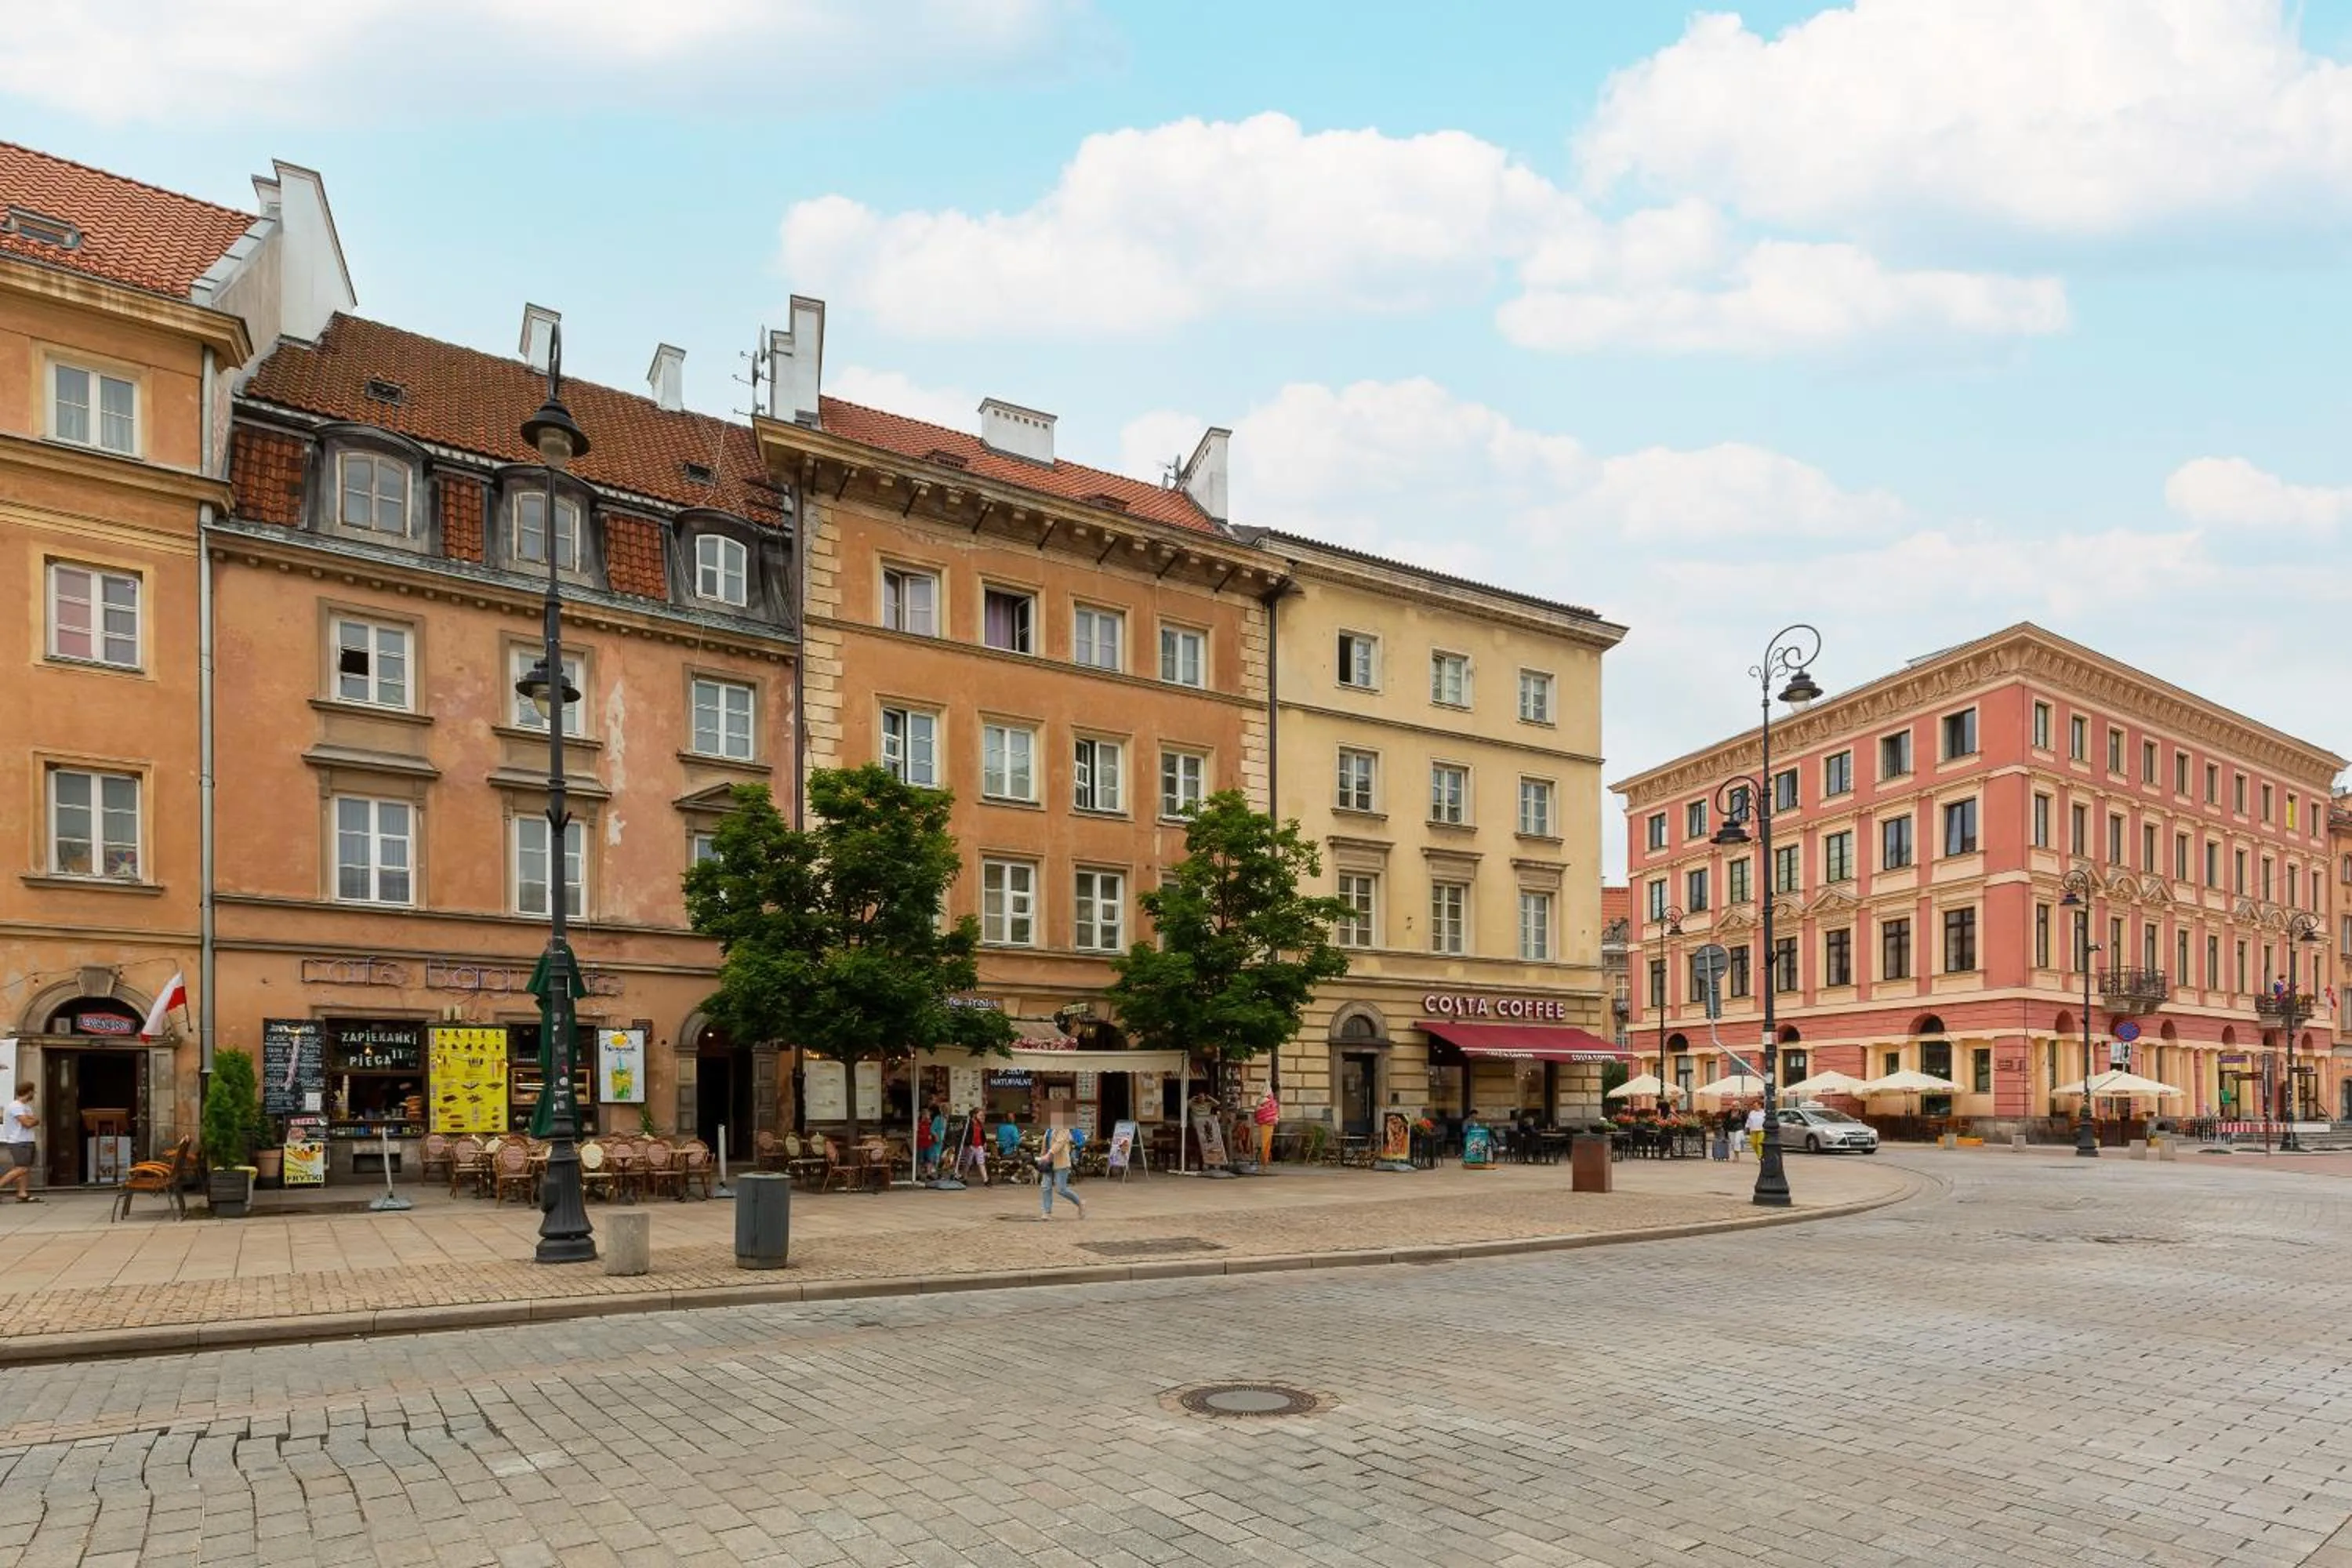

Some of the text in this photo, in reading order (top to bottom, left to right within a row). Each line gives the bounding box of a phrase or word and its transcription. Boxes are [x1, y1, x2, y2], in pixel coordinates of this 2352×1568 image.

[1425, 995, 1566, 1018] COSTA COFFEE
[340, 1030, 417, 1045] ZAPIEKANKI
